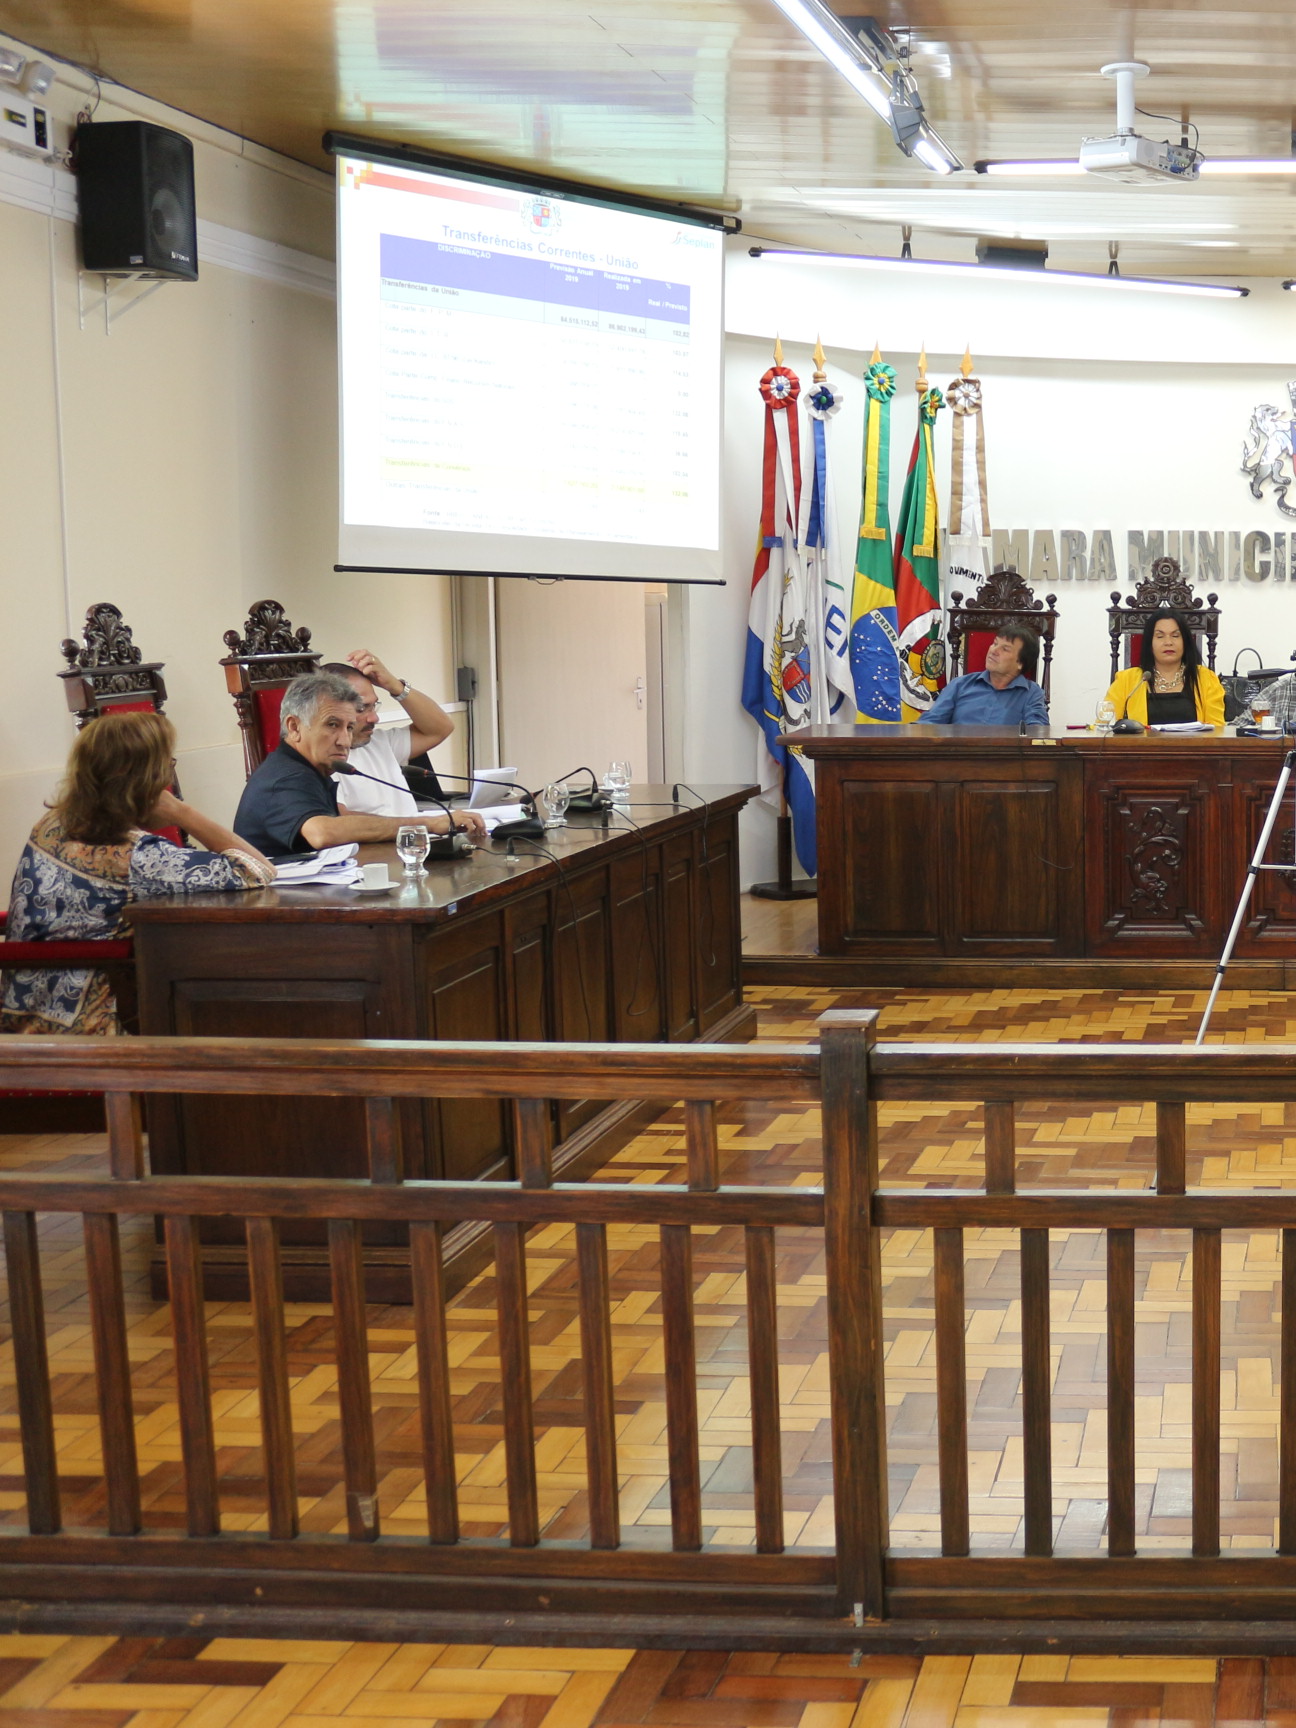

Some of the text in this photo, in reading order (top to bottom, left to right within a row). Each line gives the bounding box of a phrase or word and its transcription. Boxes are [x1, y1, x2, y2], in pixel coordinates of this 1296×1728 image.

[442, 225, 533, 252] Transferências
[538, 242, 595, 263] Correntes
[606, 254, 639, 270] União
[988, 528, 1118, 582] MARA
[873, 612, 898, 643] ORDEM
